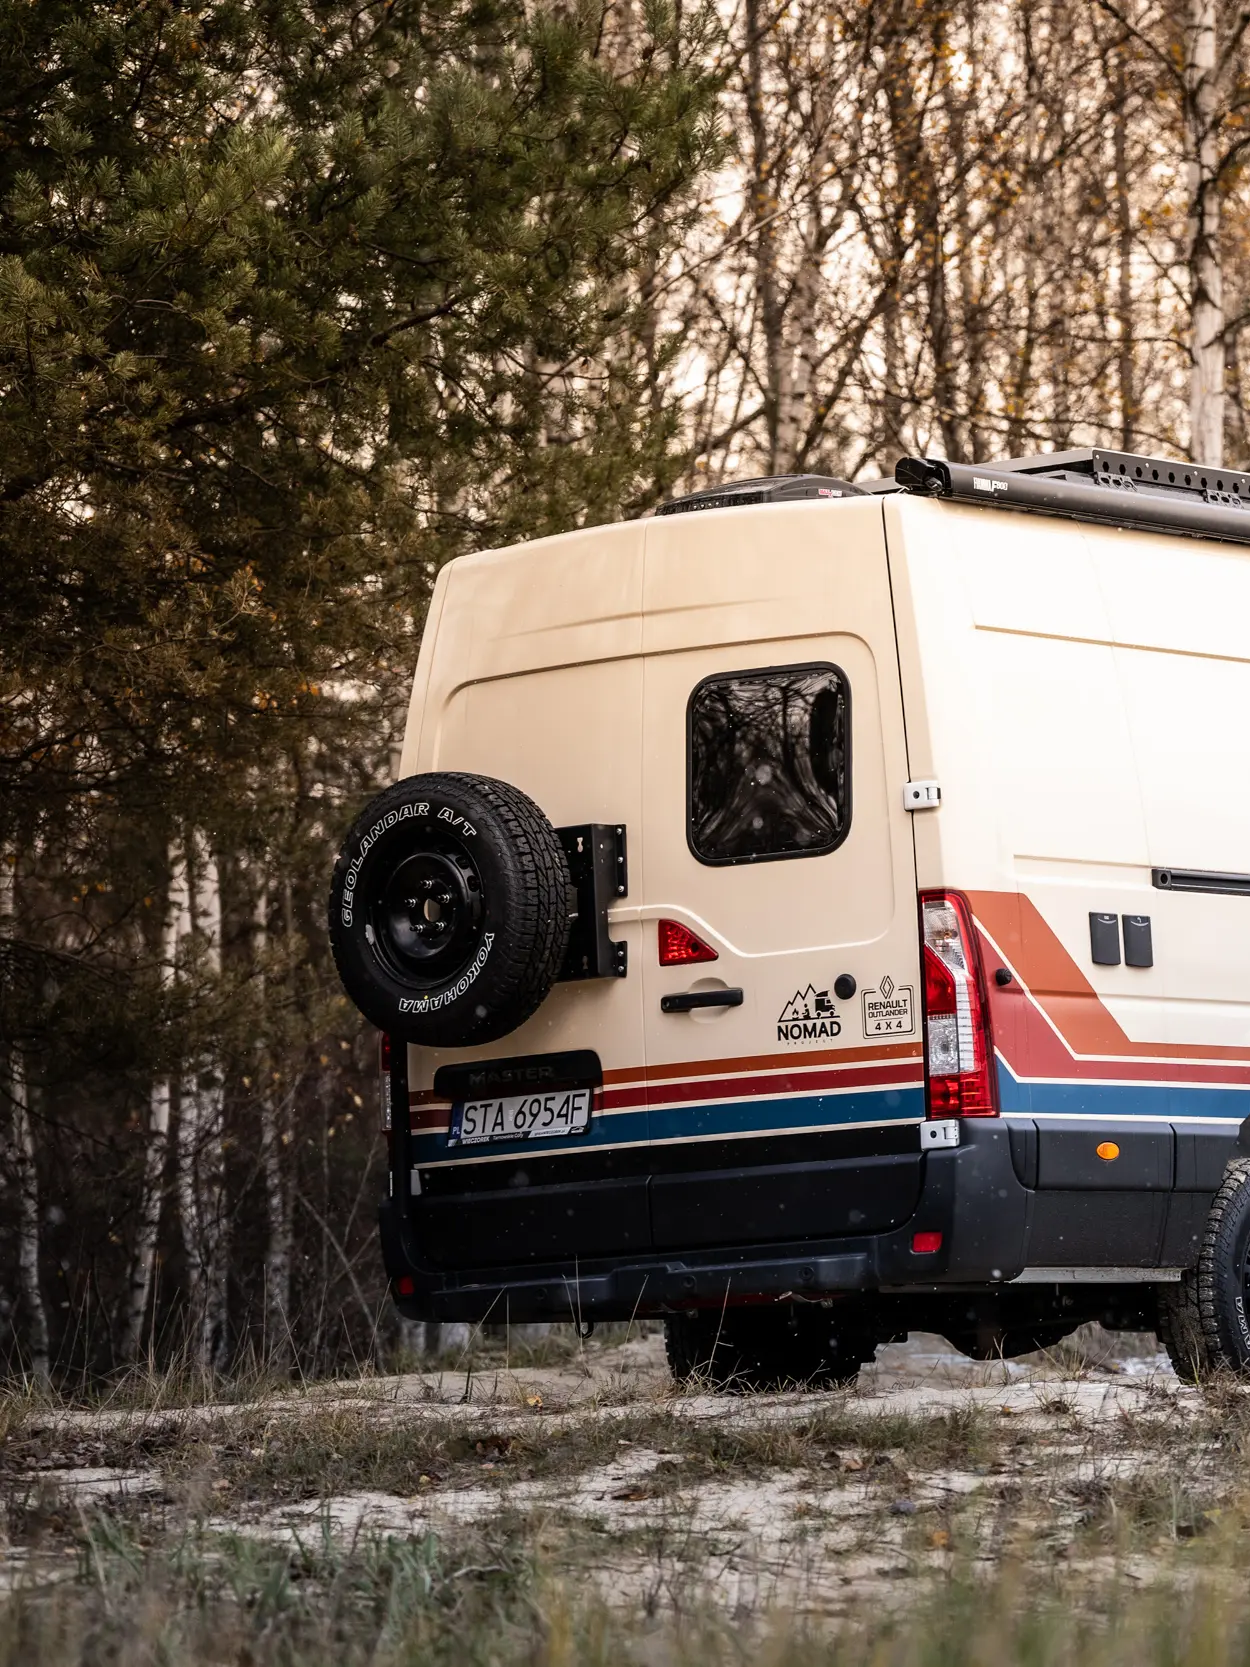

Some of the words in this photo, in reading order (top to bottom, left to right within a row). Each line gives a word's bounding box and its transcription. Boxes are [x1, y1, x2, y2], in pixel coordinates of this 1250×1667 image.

[341, 802, 430, 928] GEOLANDAR
[437, 806, 477, 838] A/T
[398, 932, 495, 1014] YOKOHAMA
[867, 999, 908, 1011] RENAULT
[867, 1008, 908, 1019] OUTLANDER
[777, 1021, 842, 1041] NOMAD
[468, 1066, 555, 1086] MASTER
[463, 1102, 505, 1135] STA
[513, 1093, 587, 1130] 6954F
[452, 1126, 461, 1135] PL
